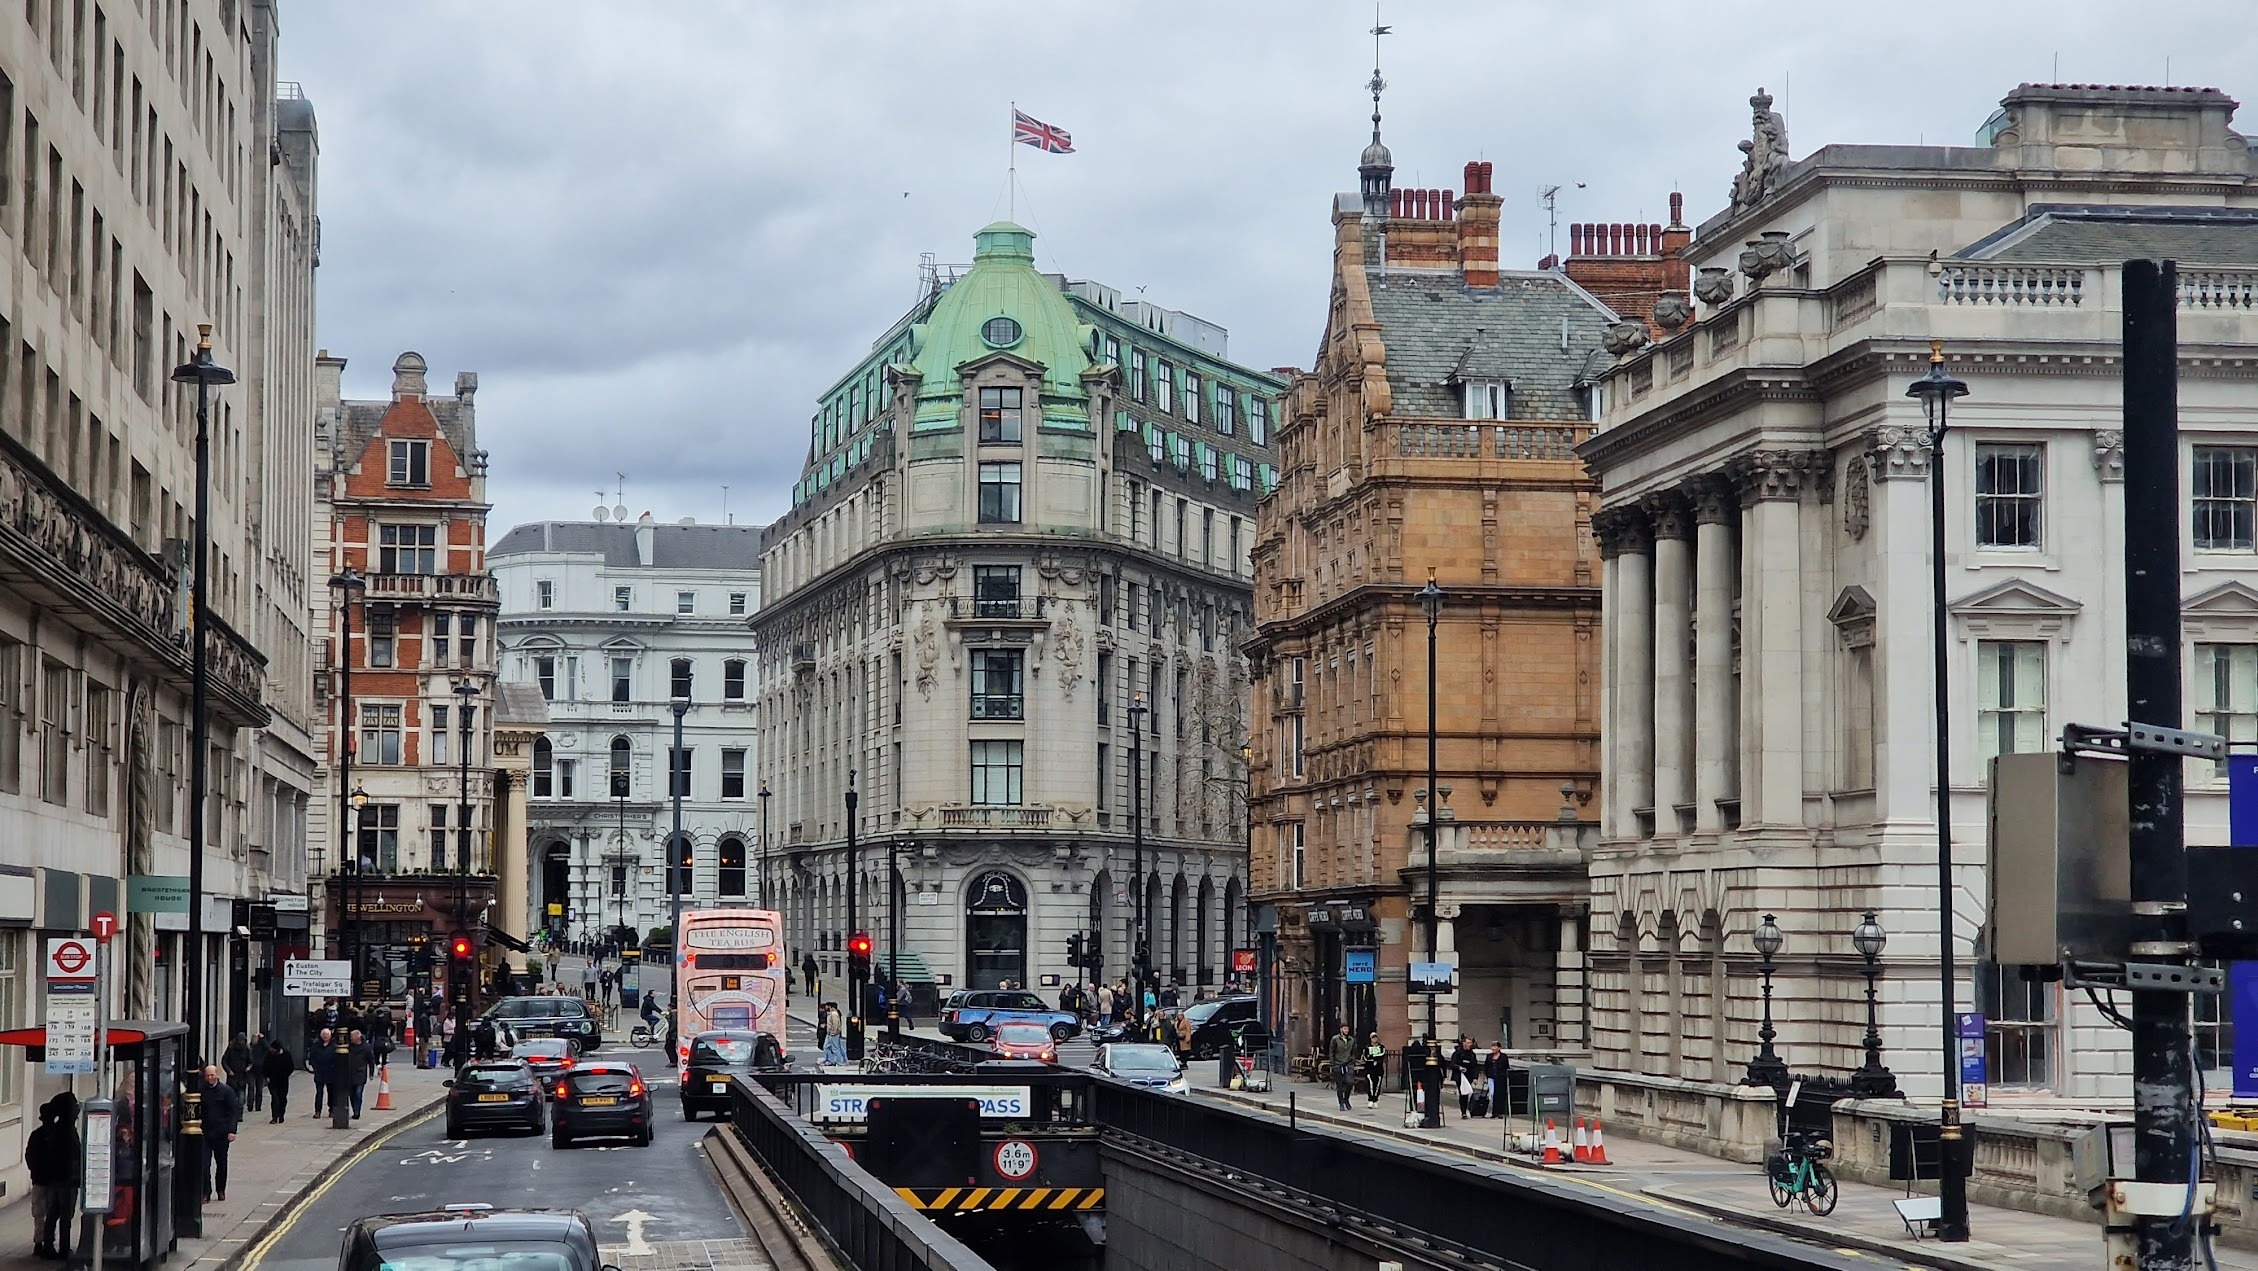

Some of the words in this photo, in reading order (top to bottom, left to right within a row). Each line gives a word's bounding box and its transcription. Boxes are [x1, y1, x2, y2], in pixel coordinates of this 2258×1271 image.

[360, 904, 422, 912] WELLINGTON
[97, 917, 112, 936] T
[720, 930, 769, 938] ENGLISH
